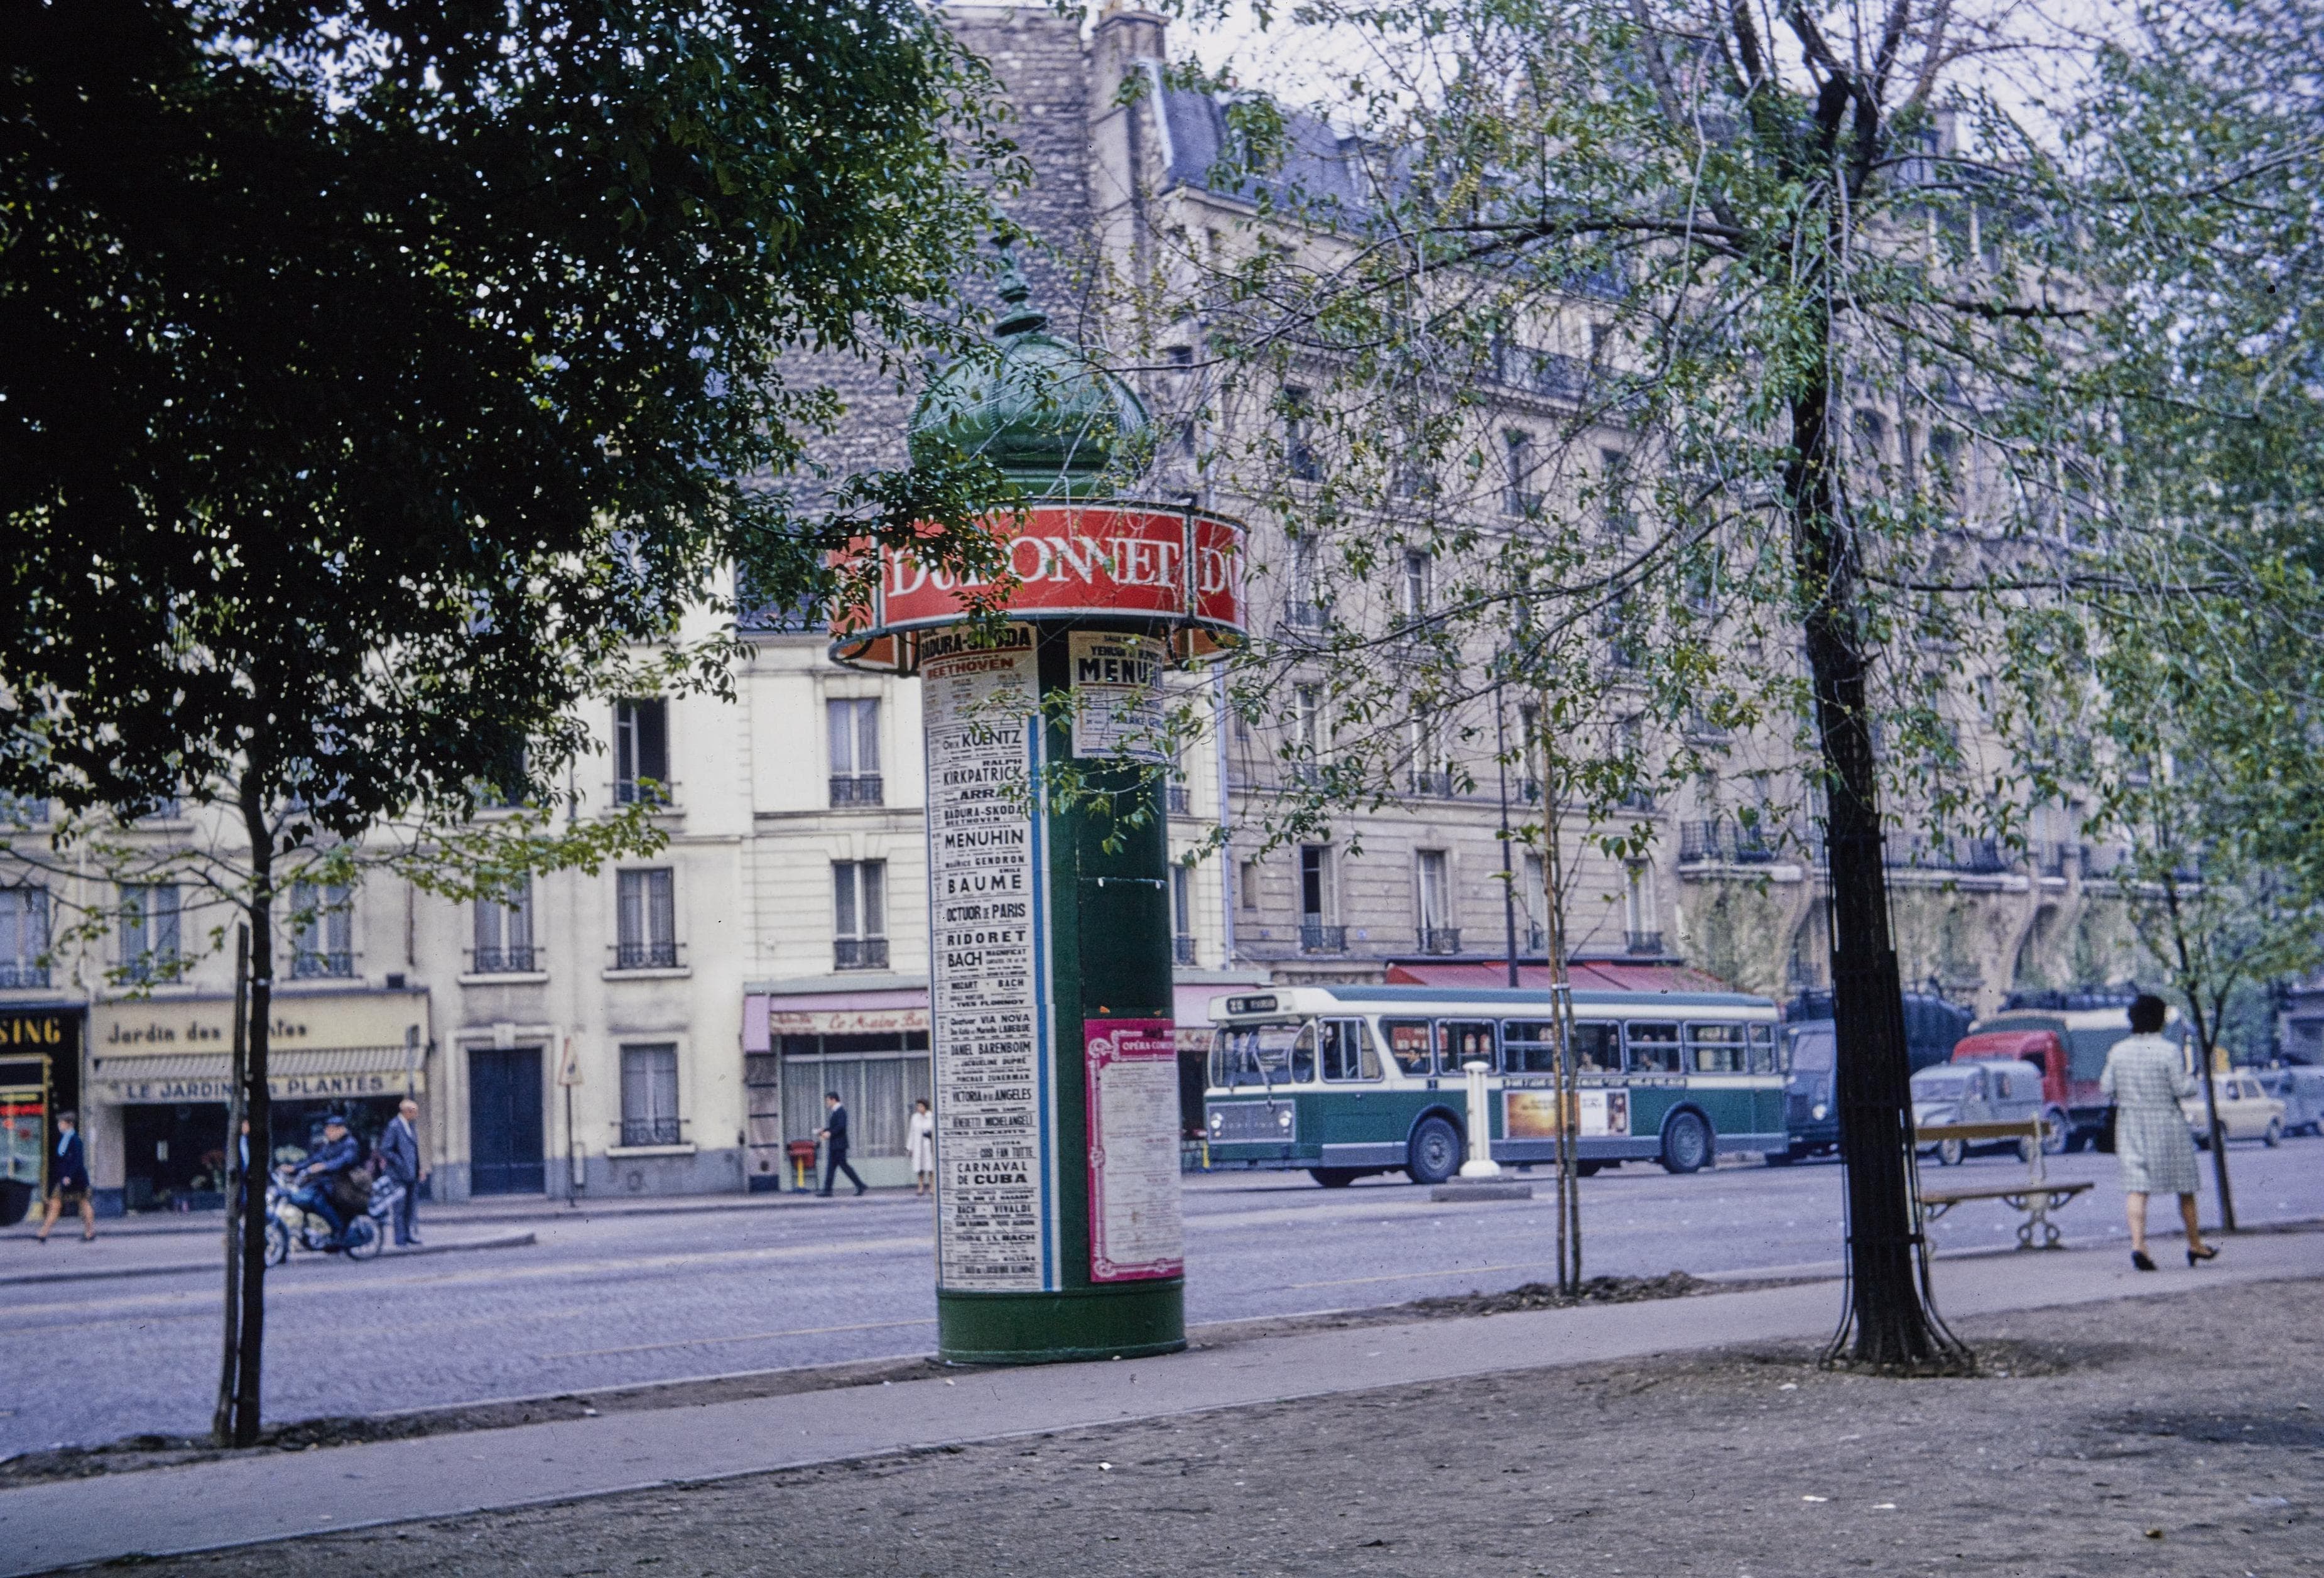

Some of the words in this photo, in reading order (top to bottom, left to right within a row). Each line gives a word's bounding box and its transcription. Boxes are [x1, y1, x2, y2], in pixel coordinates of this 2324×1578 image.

[886, 536, 1179, 597] DUONNET
[928, 658, 1014, 680] BEETHOVEN
[962, 730, 1022, 747] KUENTZ
[943, 766, 1024, 786] KIRKPATRICK
[945, 805, 1022, 820] BADURA-SKODA
[946, 817, 1000, 827] BEETHOVEN
[945, 829, 1024, 849] MENUHIN
[975, 855, 1024, 865] GENDRON
[948, 874, 1021, 894] BAUME
[947, 906, 981, 922] OCTUOR
[992, 903, 1026, 919] PARIS
[947, 930, 1026, 946] RIDORET
[948, 950, 982, 967] BACH
[952, 981, 977, 990] MOZART
[997, 978, 1024, 988] BACH
[980, 1015, 996, 1024] VIA
[1001, 1013, 1031, 1023] NOVA
[109, 1021, 175, 1044] Jardin
[187, 1020, 220, 1041] des
[951, 1043, 973, 1055] DANIEL
[979, 1041, 1031, 1055] BARENBOIM
[128, 1084, 150, 1098] LE
[161, 1082, 233, 1097] JARDIN
[287, 1077, 383, 1094] PLANTES
[952, 1091, 982, 1102] VICTORIA
[994, 1087, 1031, 1101] ANGELES
[957, 1161, 1028, 1173] CARNAVAL
[957, 1174, 969, 1185] DE
[974, 1173, 1028, 1185] CUBA
[957, 1205, 975, 1213] BACH
[994, 1203, 1031, 1212] VIVALDI
